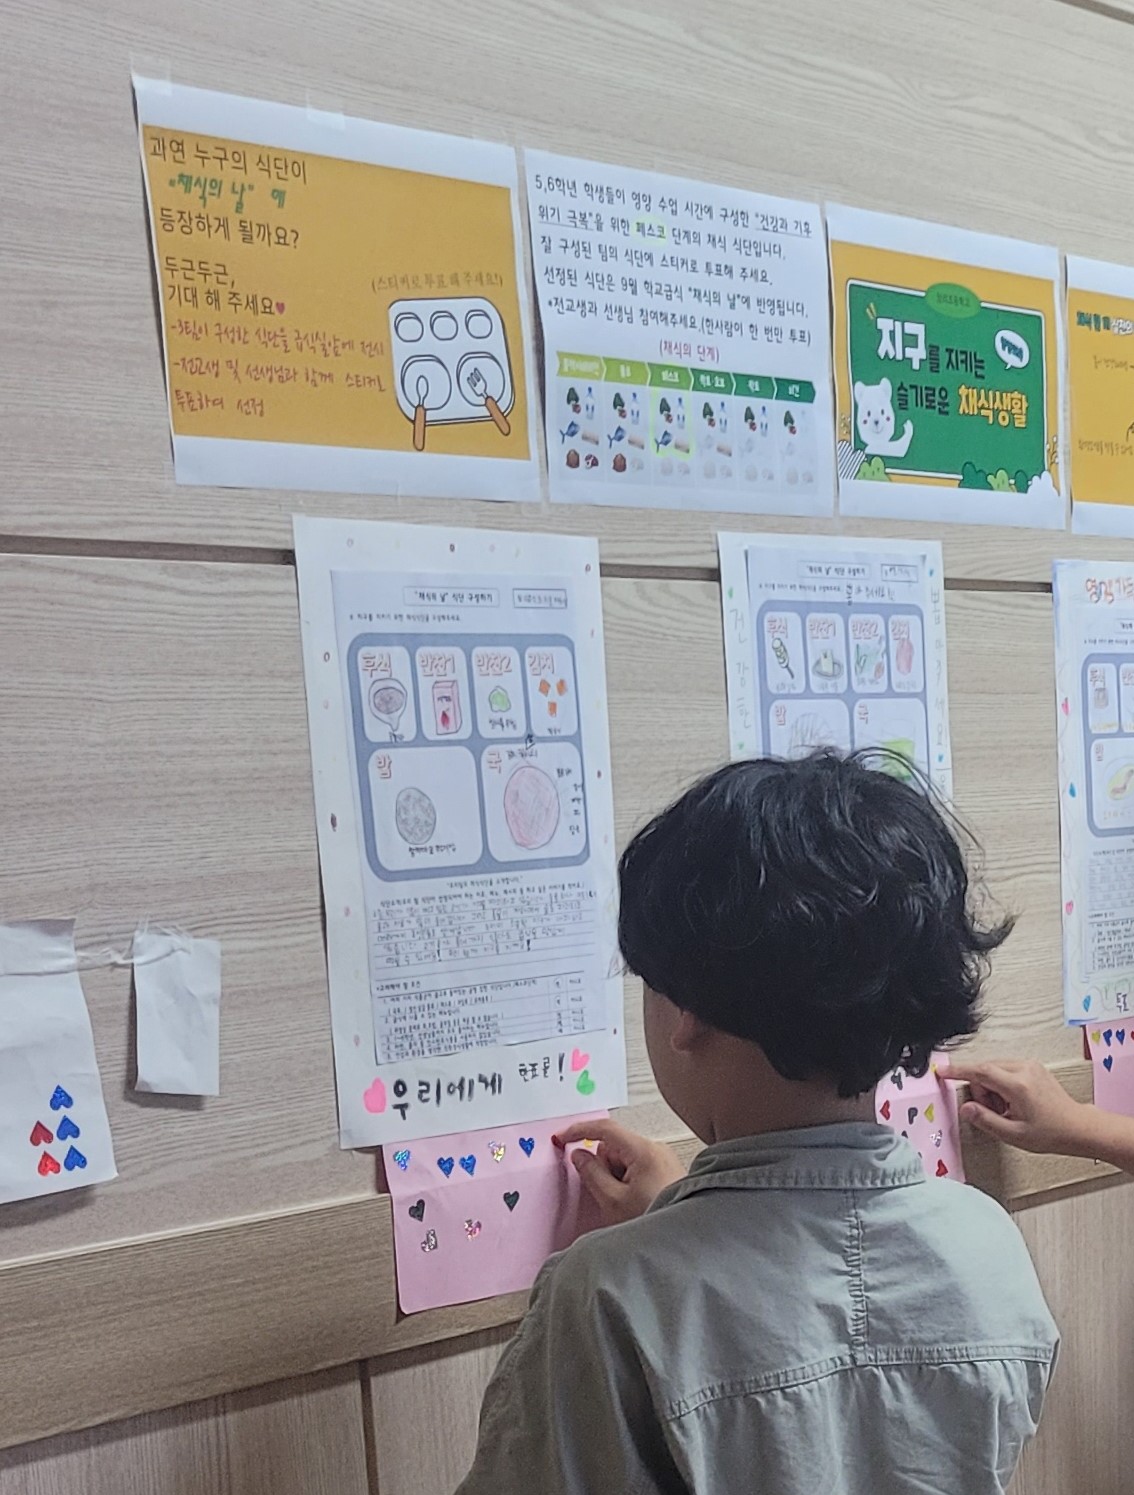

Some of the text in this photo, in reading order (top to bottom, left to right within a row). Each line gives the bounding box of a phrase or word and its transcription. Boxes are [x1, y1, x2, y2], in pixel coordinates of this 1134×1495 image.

[150, 137, 307, 184] 과연 누구의 식단이
[271, 188, 286, 208] 에
[535, 174, 578, 198] 5,6학년
[583, 181, 626, 205] 학생들이
[631, 191, 652, 213] 영양
[658, 196, 679, 216] 수업
[685, 201, 714, 221] 시간에
[719, 207, 750, 229] 구성한
[794, 220, 812, 237] 기후
[160, 207, 300, 249] 등장하게 될까요?
[538, 204, 561, 223] 위기
[610, 216, 630, 237] 위한
[635, 221, 666, 239] 페스코
[671, 227, 701, 246] 단계의
[707, 232, 727, 253] 채식
[733, 237, 786, 260] 식단입니다.
[165, 256, 235, 288] 두근두근,
[540, 235, 773, 286] 잘 구성된 팀의 식단에 스티커로 투표해 주세요.
[167, 284, 276, 315] 기대 해 주세요
[543, 266, 578, 287] 선정된
[585, 270, 616, 292] 식단은
[621, 276, 638, 296] 9월
[643, 280, 683, 302] 학교급식
[756, 297, 809, 318] 반영됩니다.
[214, 322, 249, 344] 구성한
[255, 327, 290, 353] 식단을
[603, 302, 634, 325] 선생님
[749, 324, 758, 341] 한
[764, 325, 783, 344] 번만
[789, 328, 811, 347] 투표)
[659, 338, 720, 363] (채식의 단계)
[945, 348, 985, 379] 지키는
[245, 364, 298, 384] 선생님과
[897, 382, 1029, 428] 슬기로운 채식생활
[361, 654, 392, 679] 후식
[419, 654, 456, 677] 반찬1
[476, 654, 512, 677] 반찬2
[528, 653, 554, 676] 김치
[376, 754, 392, 779] 밥
[392, 1072, 502, 1120] 우리에게
